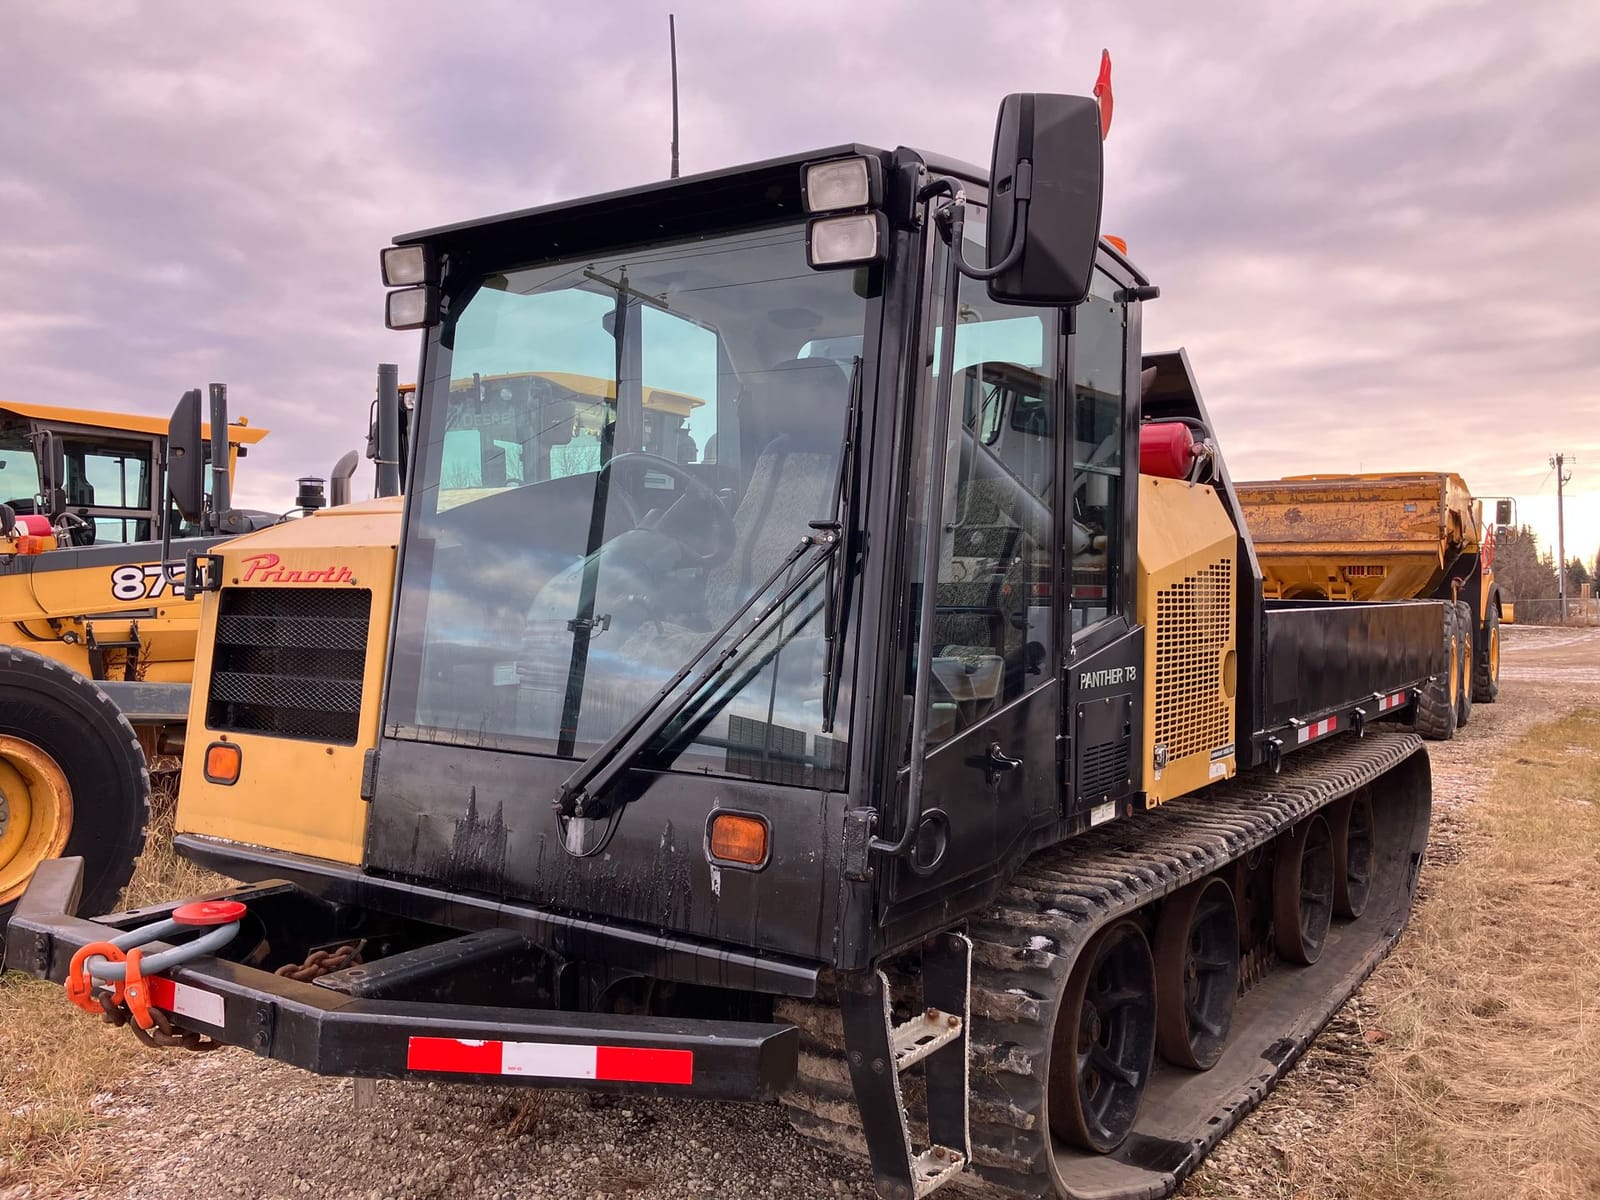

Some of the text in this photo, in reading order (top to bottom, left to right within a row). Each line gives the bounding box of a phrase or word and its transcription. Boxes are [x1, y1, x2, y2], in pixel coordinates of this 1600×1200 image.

[241, 553, 352, 582] Prinoth
[1080, 666, 1137, 689] PANTHER T8
